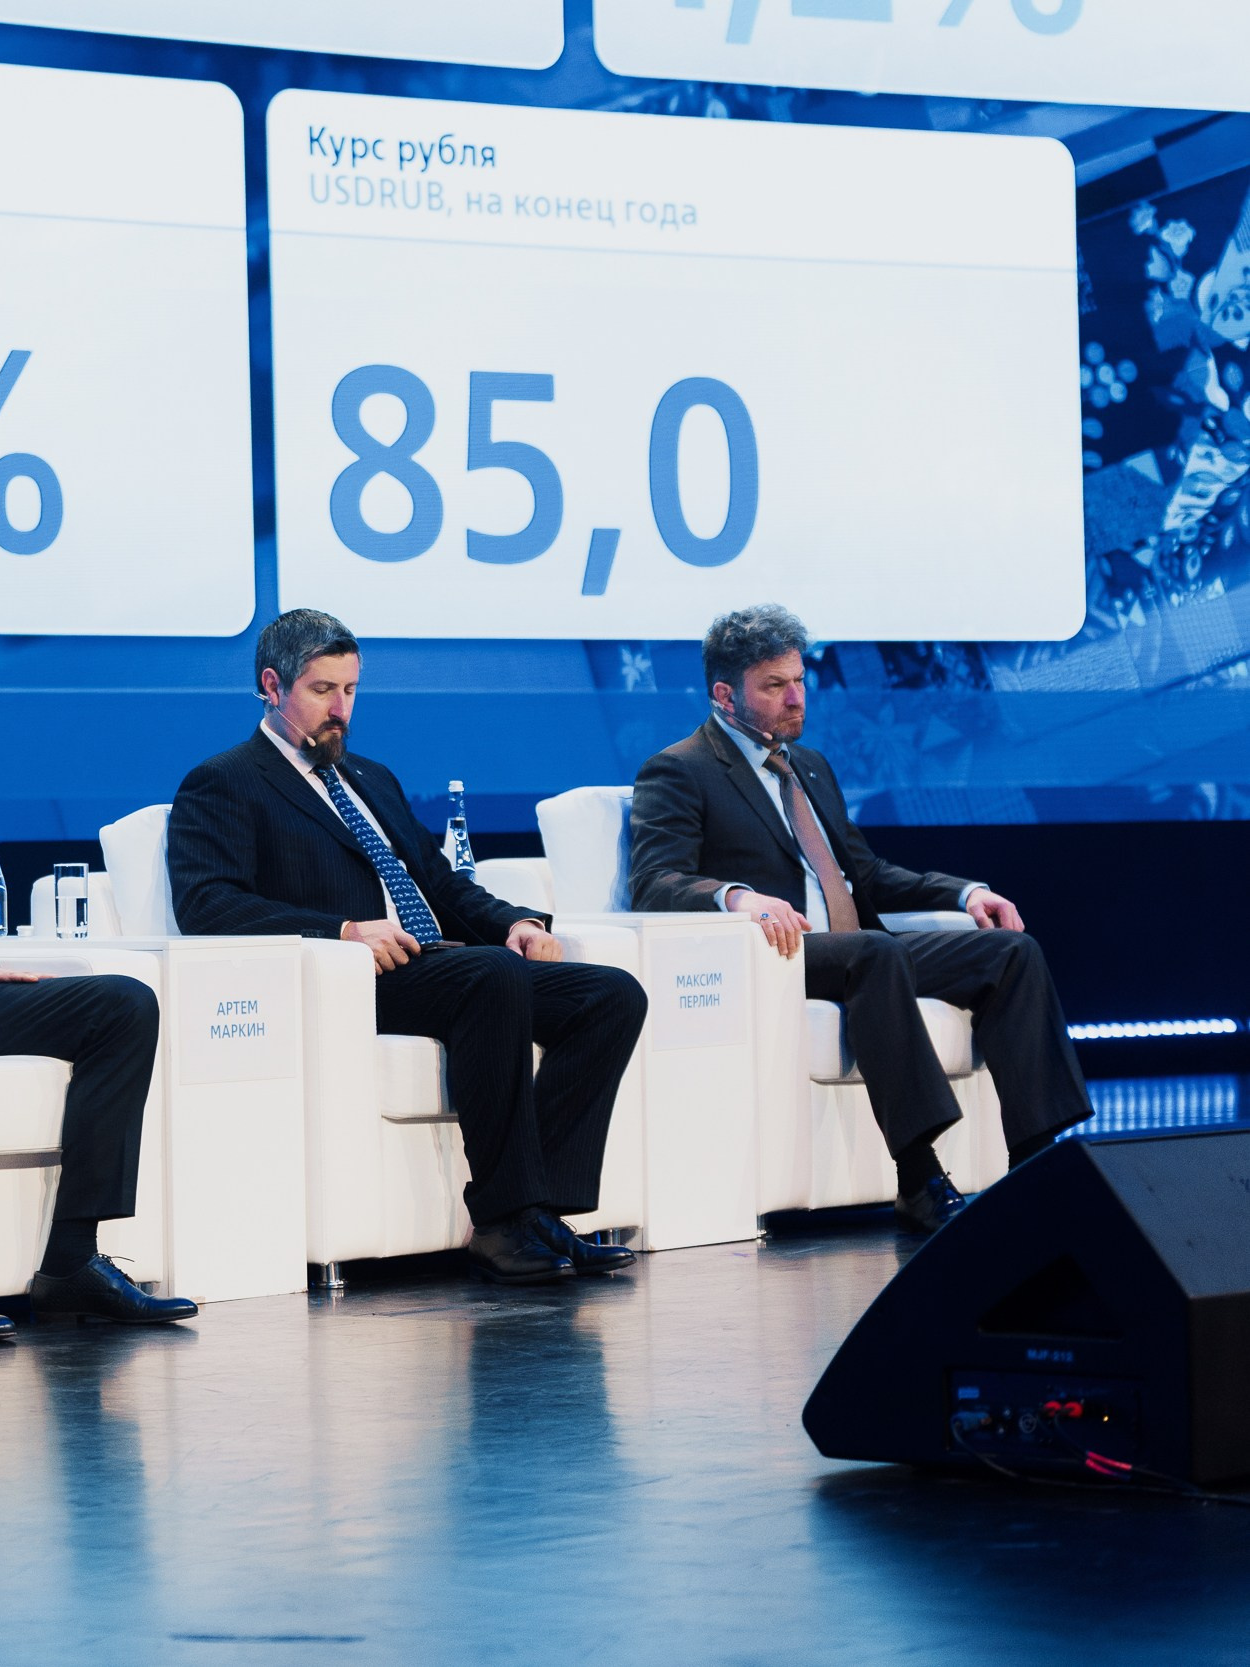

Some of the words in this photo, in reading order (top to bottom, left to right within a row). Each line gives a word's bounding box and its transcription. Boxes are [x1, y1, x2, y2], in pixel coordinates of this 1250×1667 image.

[308, 125, 385, 168] Курс
[398, 134, 497, 172] рубля
[309, 173, 453, 217] USDRUB,
[465, 191, 503, 216] на
[514, 194, 616, 227] конец
[624, 199, 698, 231] года
[329, 363, 760, 597] 85,0
[676, 972, 723, 988] МАКСИМ
[216, 999, 258, 1016] АРТЕМ
[679, 993, 720, 1009] ПЕРЛИН
[210, 1022, 265, 1039] МАРКИН
